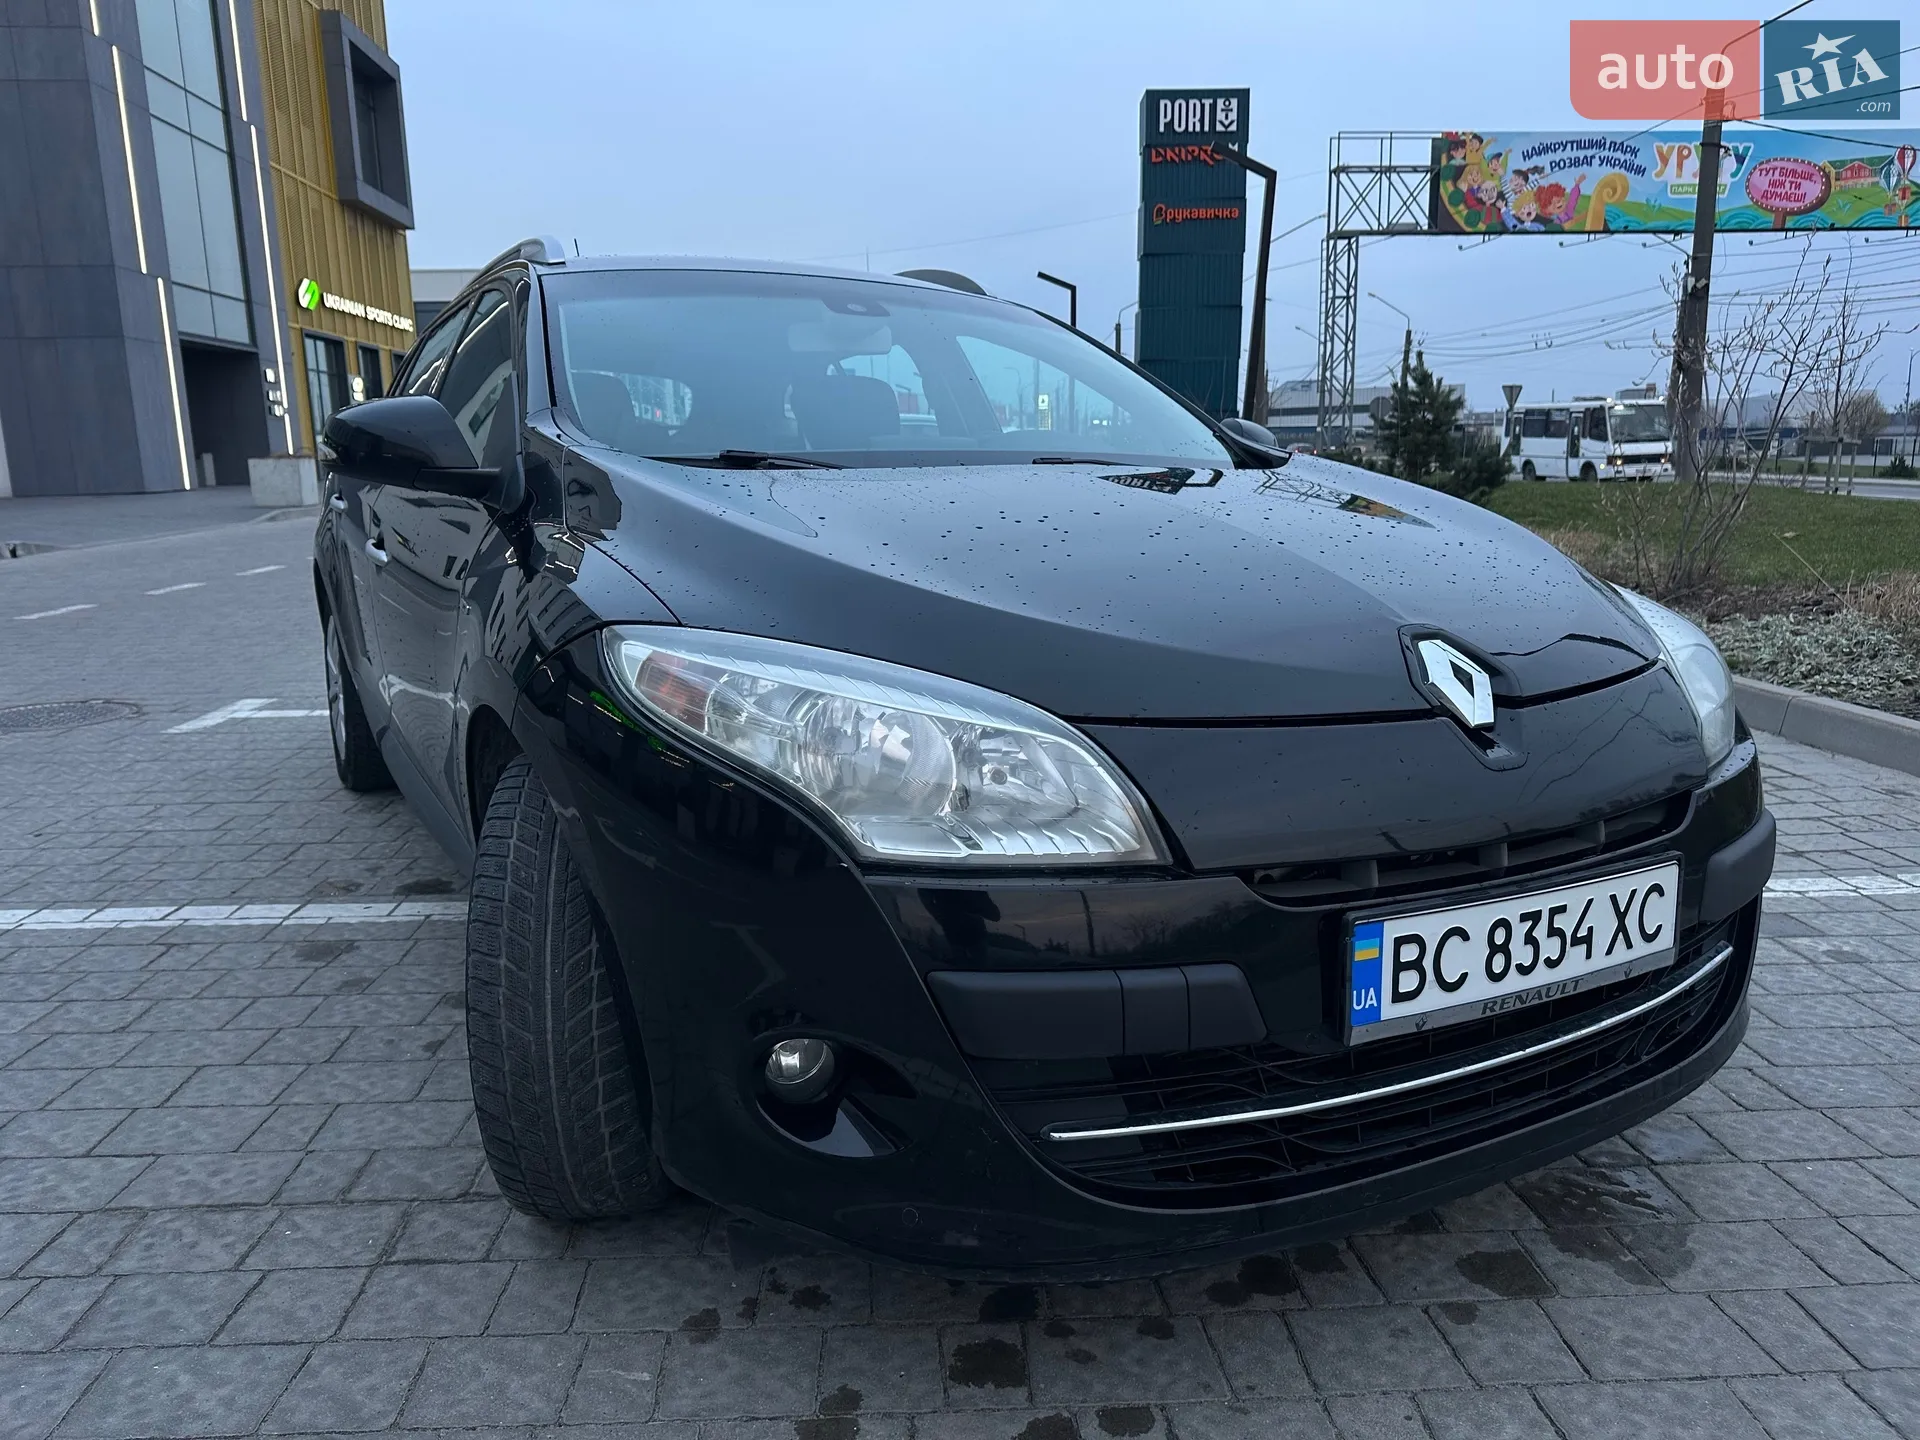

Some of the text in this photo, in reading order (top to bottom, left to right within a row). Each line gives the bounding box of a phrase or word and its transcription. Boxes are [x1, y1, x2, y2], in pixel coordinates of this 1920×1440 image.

[1158, 98, 1213, 133] PORT
[1521, 136, 1640, 162] НАЙКРУТІШИЙ ПАРК
[1549, 155, 1647, 177] РОЗВАГ УКРАЇНИ
[1758, 167, 1817, 184] ТУТ БІЛЬШЕ,
[1671, 184, 1694, 194] ПАРК
[1768, 179, 1801, 190] НІЖ ТИ
[1761, 190, 1807, 204] ДУМАЄШ!
[323, 292, 414, 332] UKRAINIAN SPORTS CLINIC
[1391, 882, 1666, 1004] BC 8354 XC
[1352, 987, 1378, 1011] UA
[1480, 978, 1585, 1016] RENAULT
